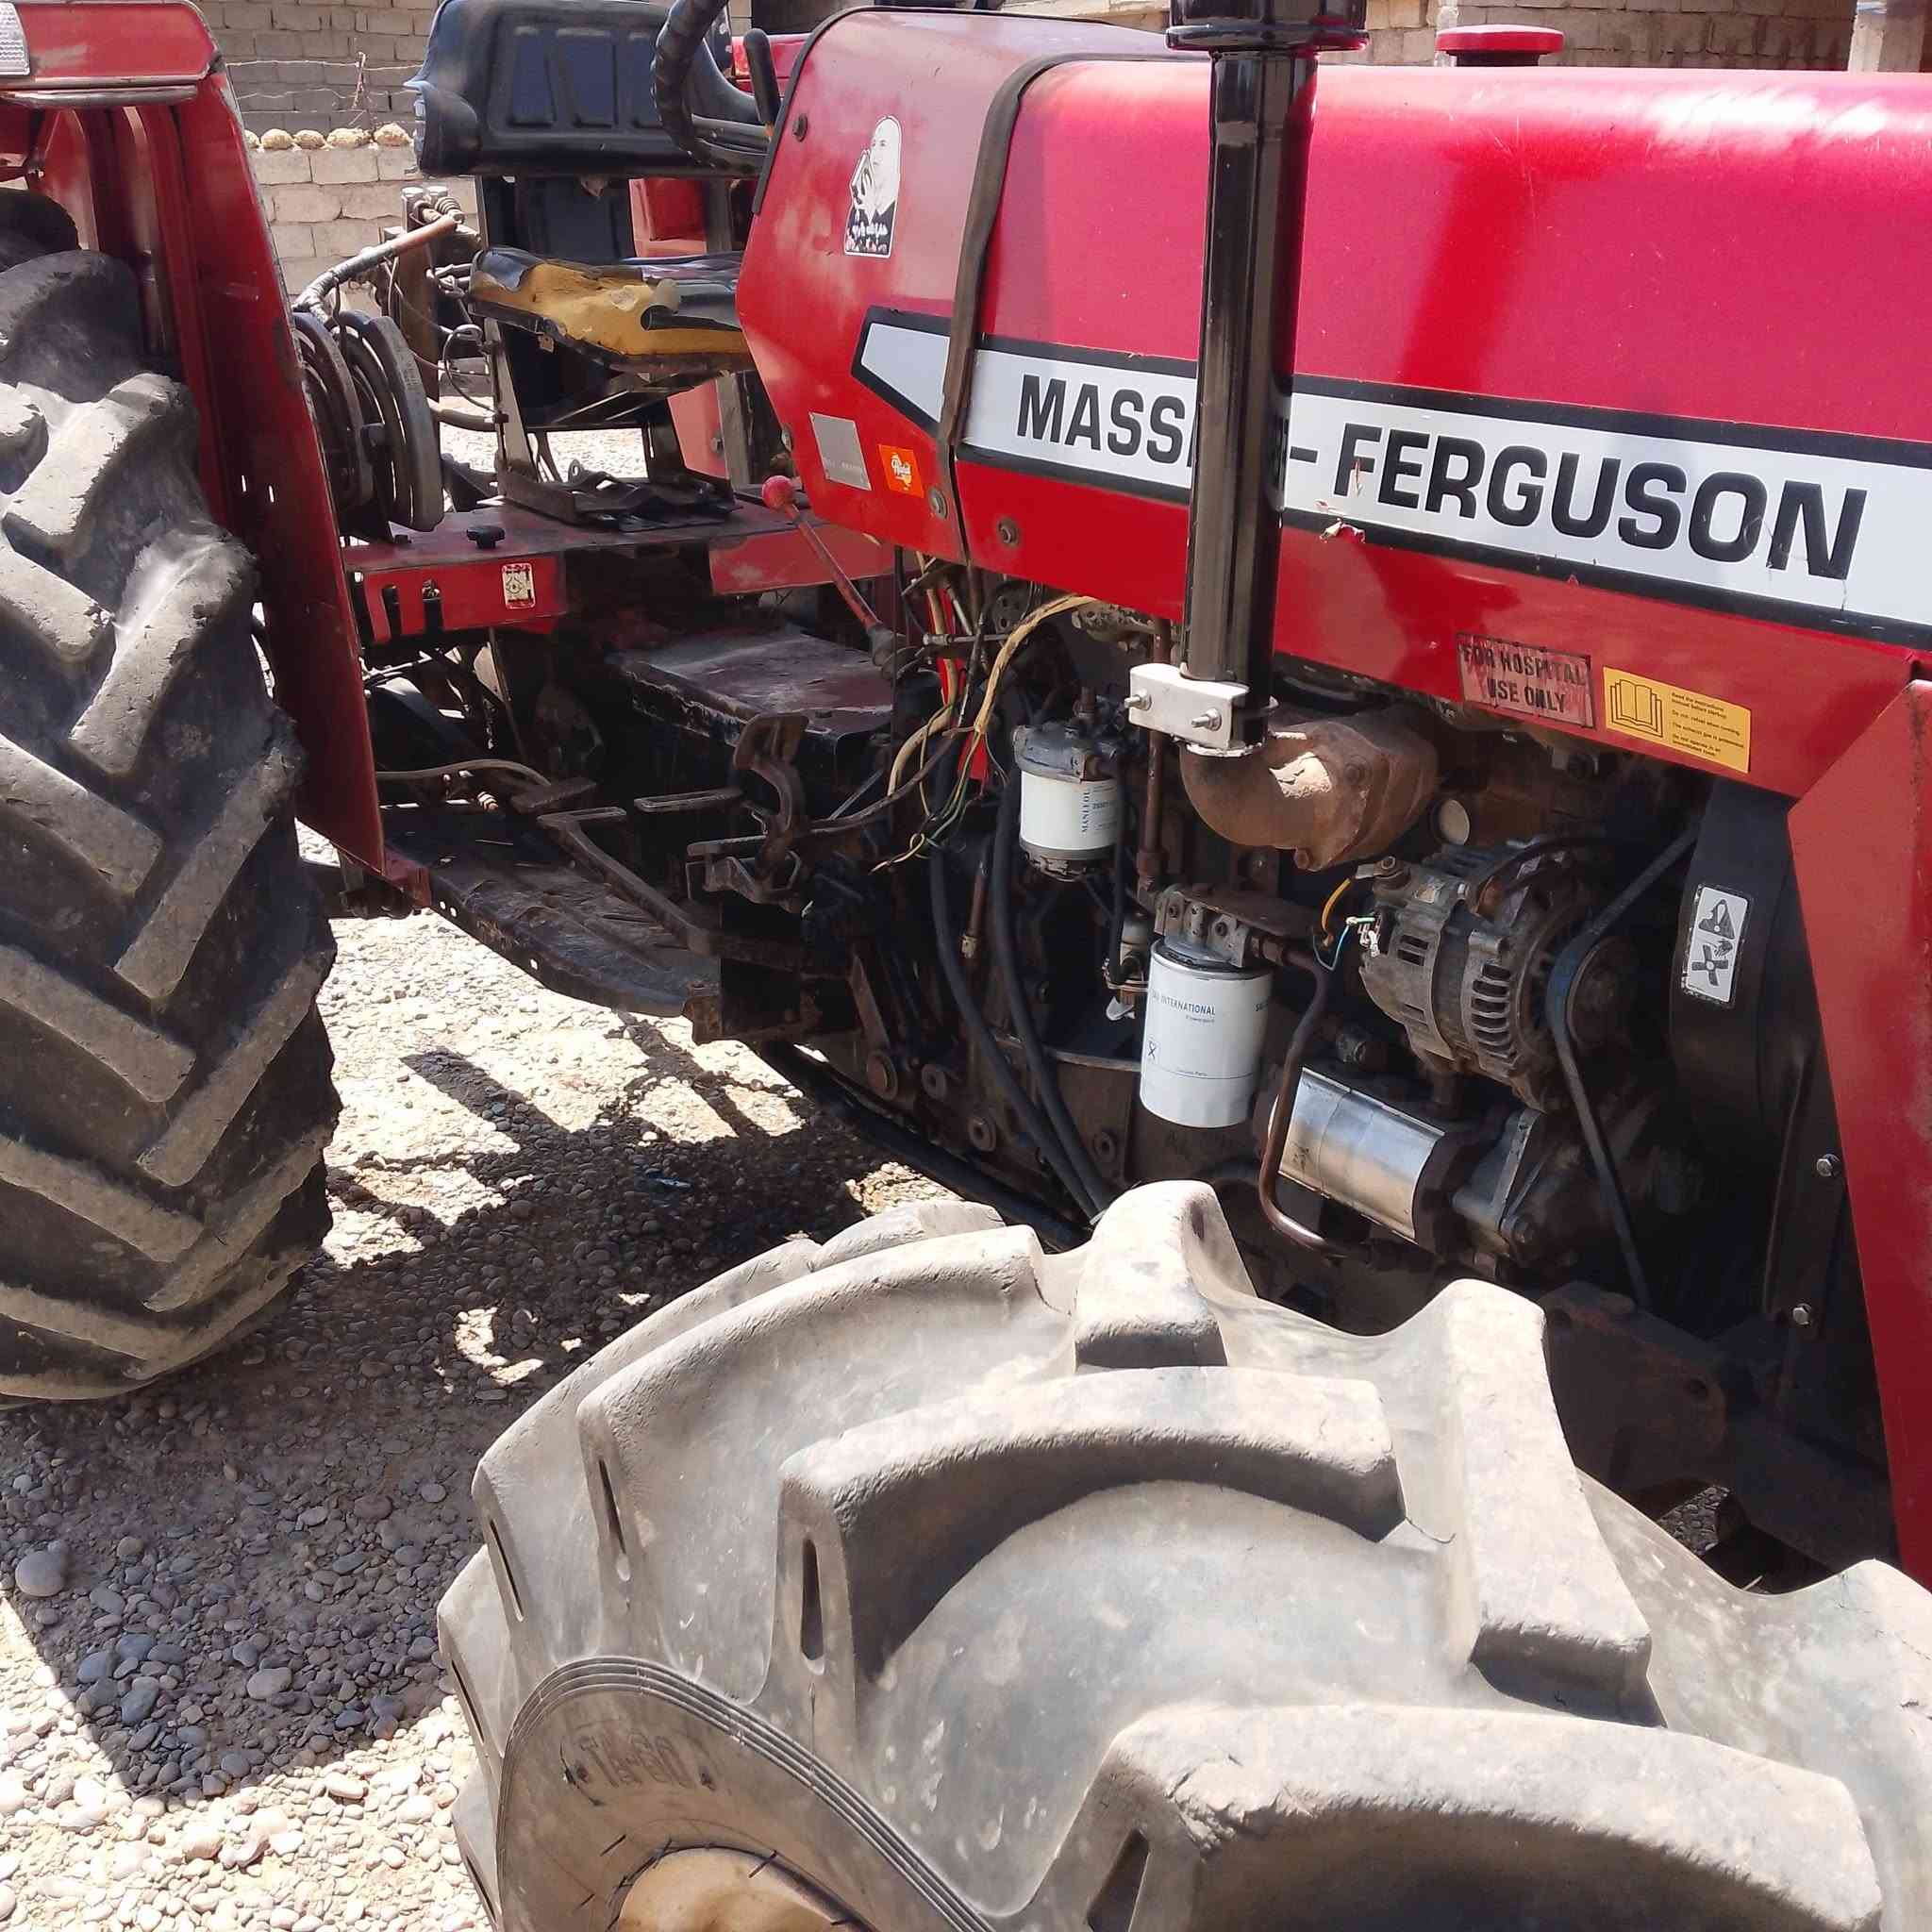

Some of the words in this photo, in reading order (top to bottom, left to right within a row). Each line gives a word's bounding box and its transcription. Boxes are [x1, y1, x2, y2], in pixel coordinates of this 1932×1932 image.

[1487, 678, 1519, 703] USE
[1524, 685, 1566, 713] ONLY
[1160, 995, 1216, 1016] INTERNATIONAL
